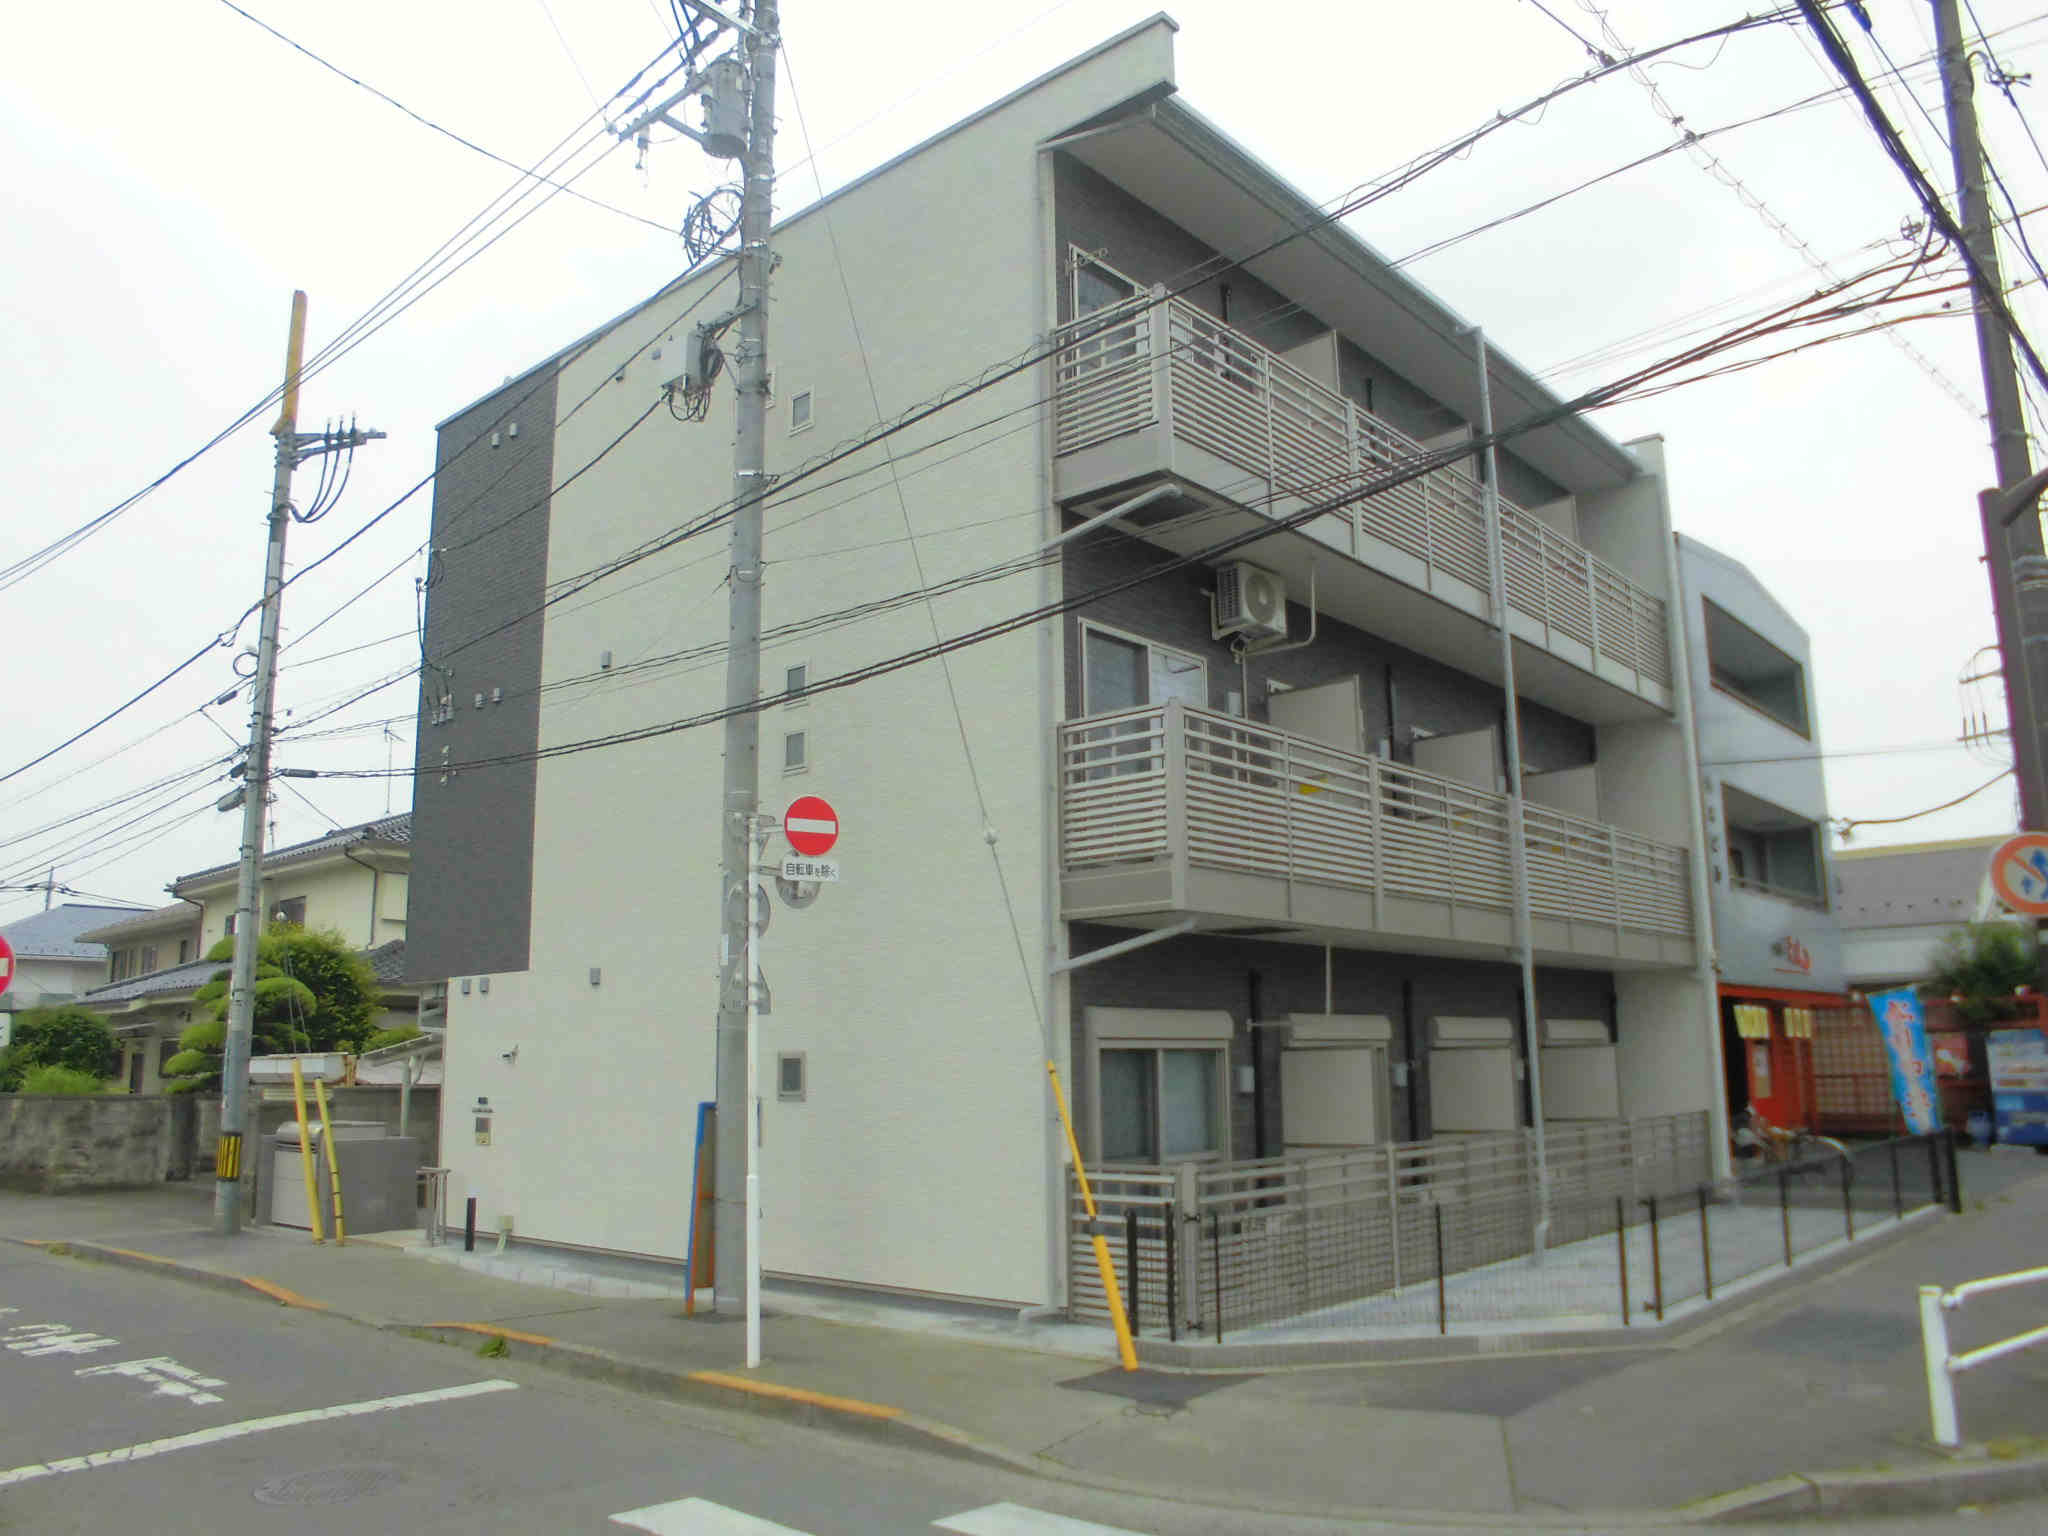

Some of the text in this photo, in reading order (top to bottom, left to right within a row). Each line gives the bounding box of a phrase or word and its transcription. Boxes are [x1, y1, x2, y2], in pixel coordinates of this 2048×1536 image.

[785, 862, 836, 878] 自転車を除く
